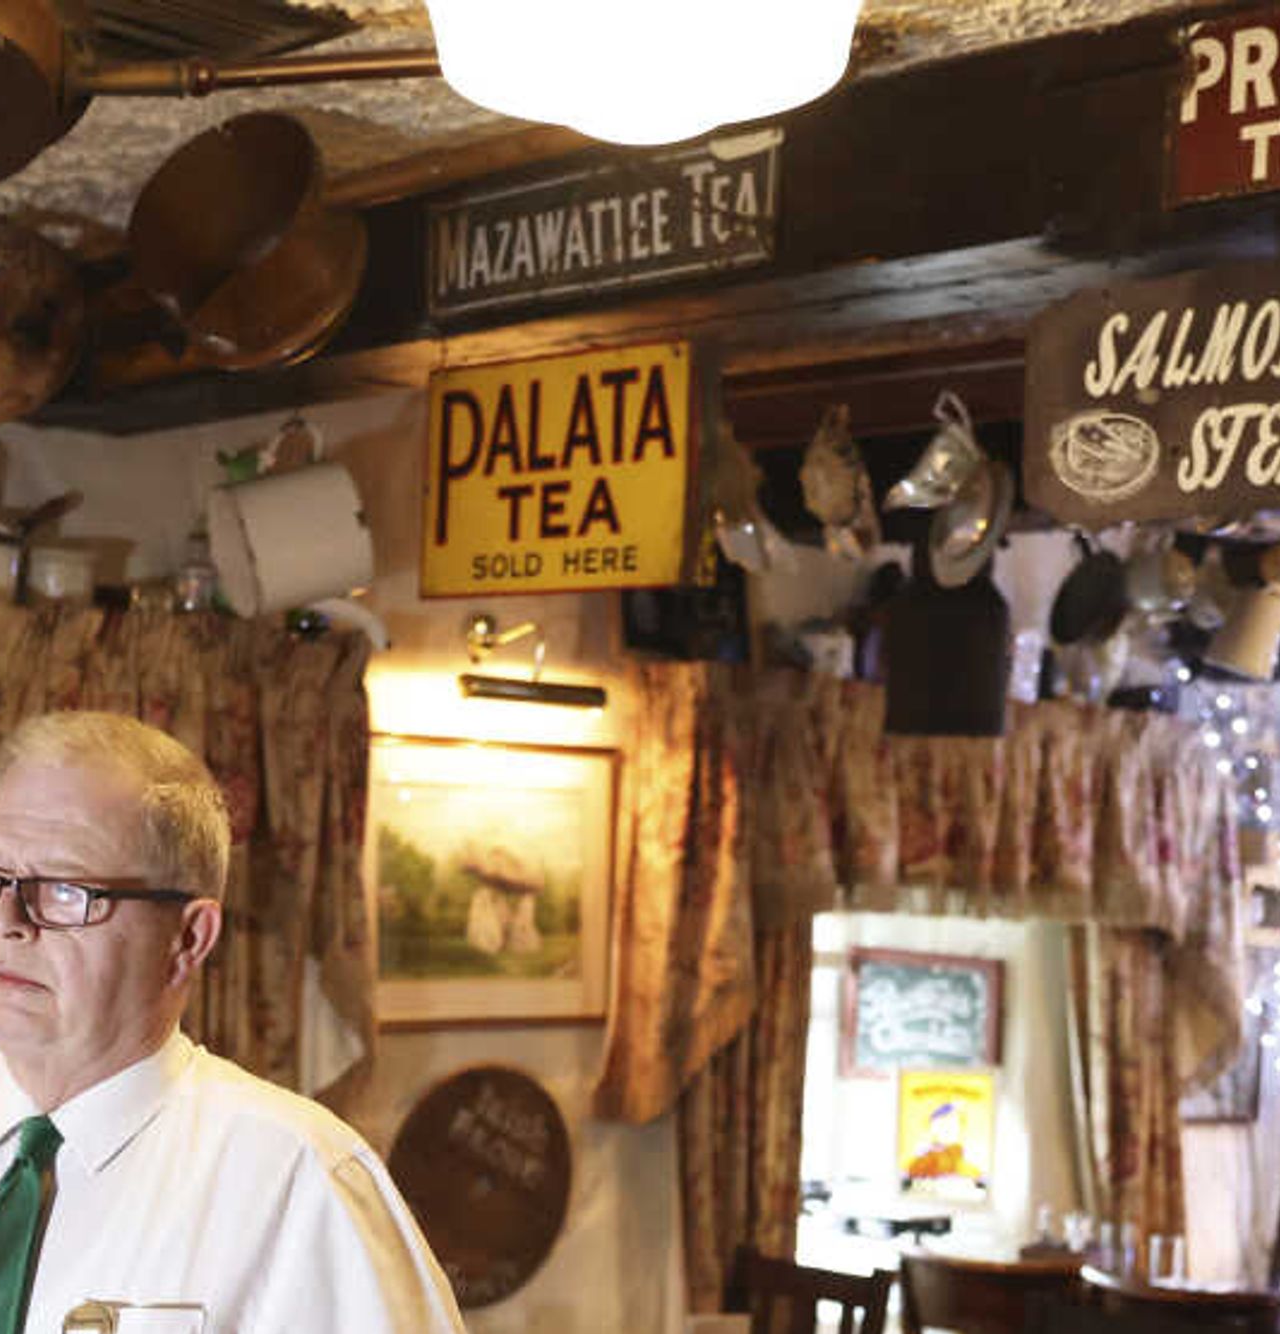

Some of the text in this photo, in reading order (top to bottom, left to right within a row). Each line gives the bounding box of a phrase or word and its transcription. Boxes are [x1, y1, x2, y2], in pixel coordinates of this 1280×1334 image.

[438, 160, 758, 296] MAZAWATTEE TEA
[435, 365, 675, 546] PALATA
[498, 478, 621, 542] TEA
[471, 545, 639, 580] SOLD HERE
